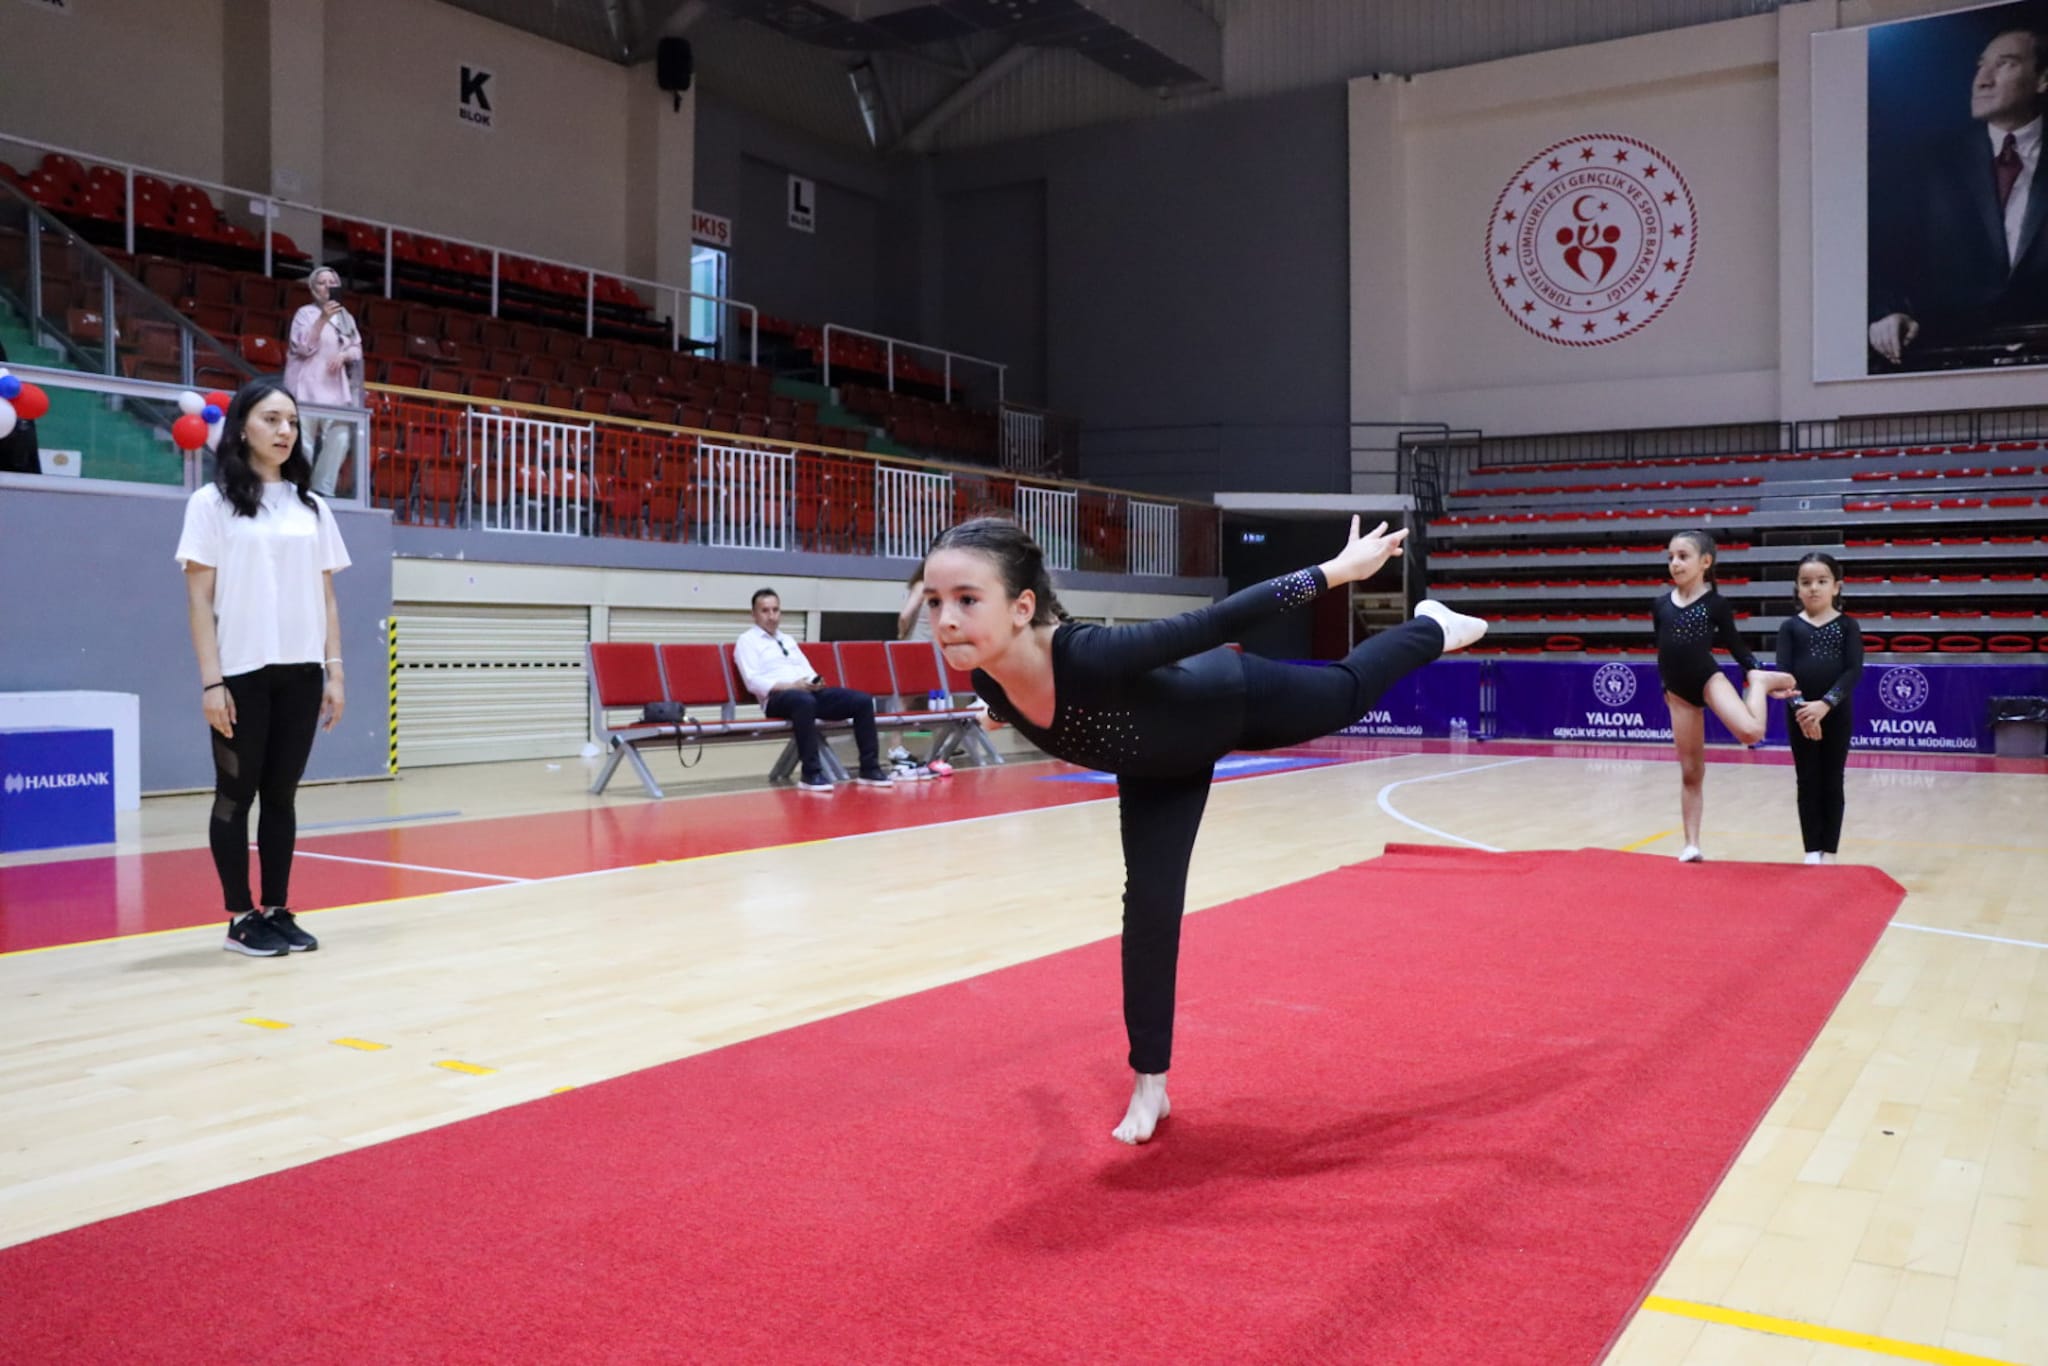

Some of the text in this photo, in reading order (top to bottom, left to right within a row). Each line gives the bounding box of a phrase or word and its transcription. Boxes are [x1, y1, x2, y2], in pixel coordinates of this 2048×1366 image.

[461, 66, 492, 111] K
[459, 107, 491, 127] BLOK
[794, 181, 810, 215] L
[692, 213, 728, 241] IKIŞ
[1521, 172, 1657, 307] TÜRKİYE CUMHURİYETİ GENÇLİK VE SPOR BAKANLIĞI
[1359, 709, 1392, 724] OVA
[1585, 712, 1644, 726] YALOVA
[1553, 726, 1585, 739] GENÇLİK
[1585, 728, 1596, 738] VE
[1597, 728, 1617, 738] SPOR
[1627, 728, 1673, 740] MÜDÜRLÜĞ
[1870, 719, 1937, 734] YALOVA
[1849, 735, 1869, 747] ÇLİK
[1869, 737, 1881, 746] VE
[1882, 737, 1906, 747] SPOR
[1917, 737, 1977, 749] MÜDÜRLÜĞÜ
[25, 771, 110, 790] HALKBANK
